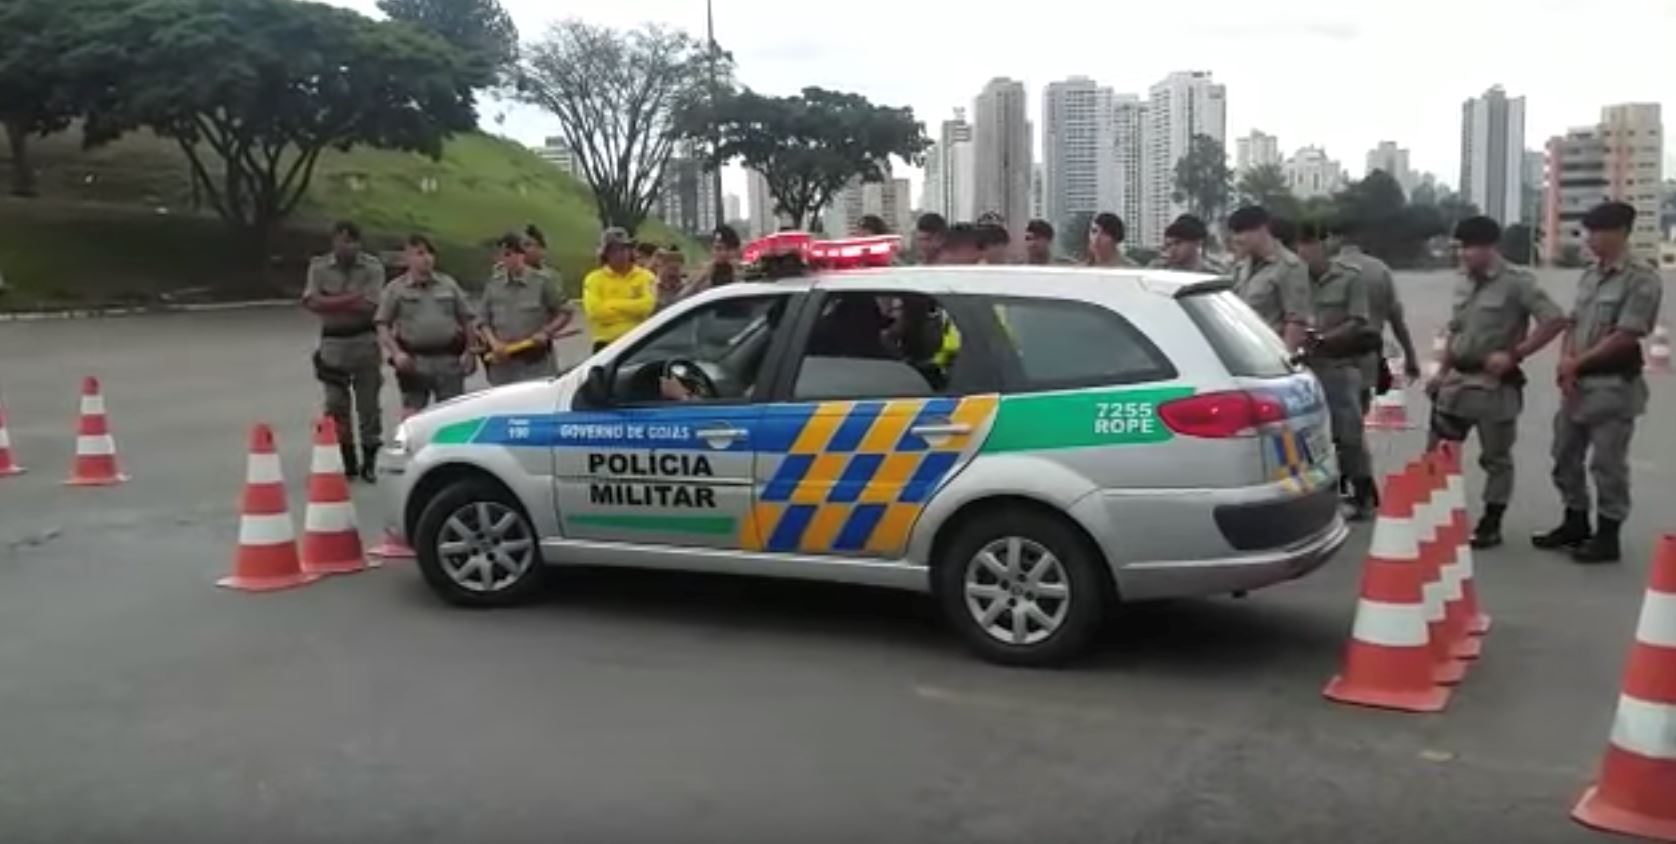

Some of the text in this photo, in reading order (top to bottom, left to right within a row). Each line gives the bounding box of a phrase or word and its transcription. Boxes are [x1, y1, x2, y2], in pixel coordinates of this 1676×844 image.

[1096, 402, 1152, 417] 7255
[560, 423, 622, 439] GOVERNO
[627, 424, 645, 439] DE
[1094, 418, 1155, 433] ROPE
[588, 450, 714, 476] POLÍCIA
[589, 484, 716, 508] MILITAR
